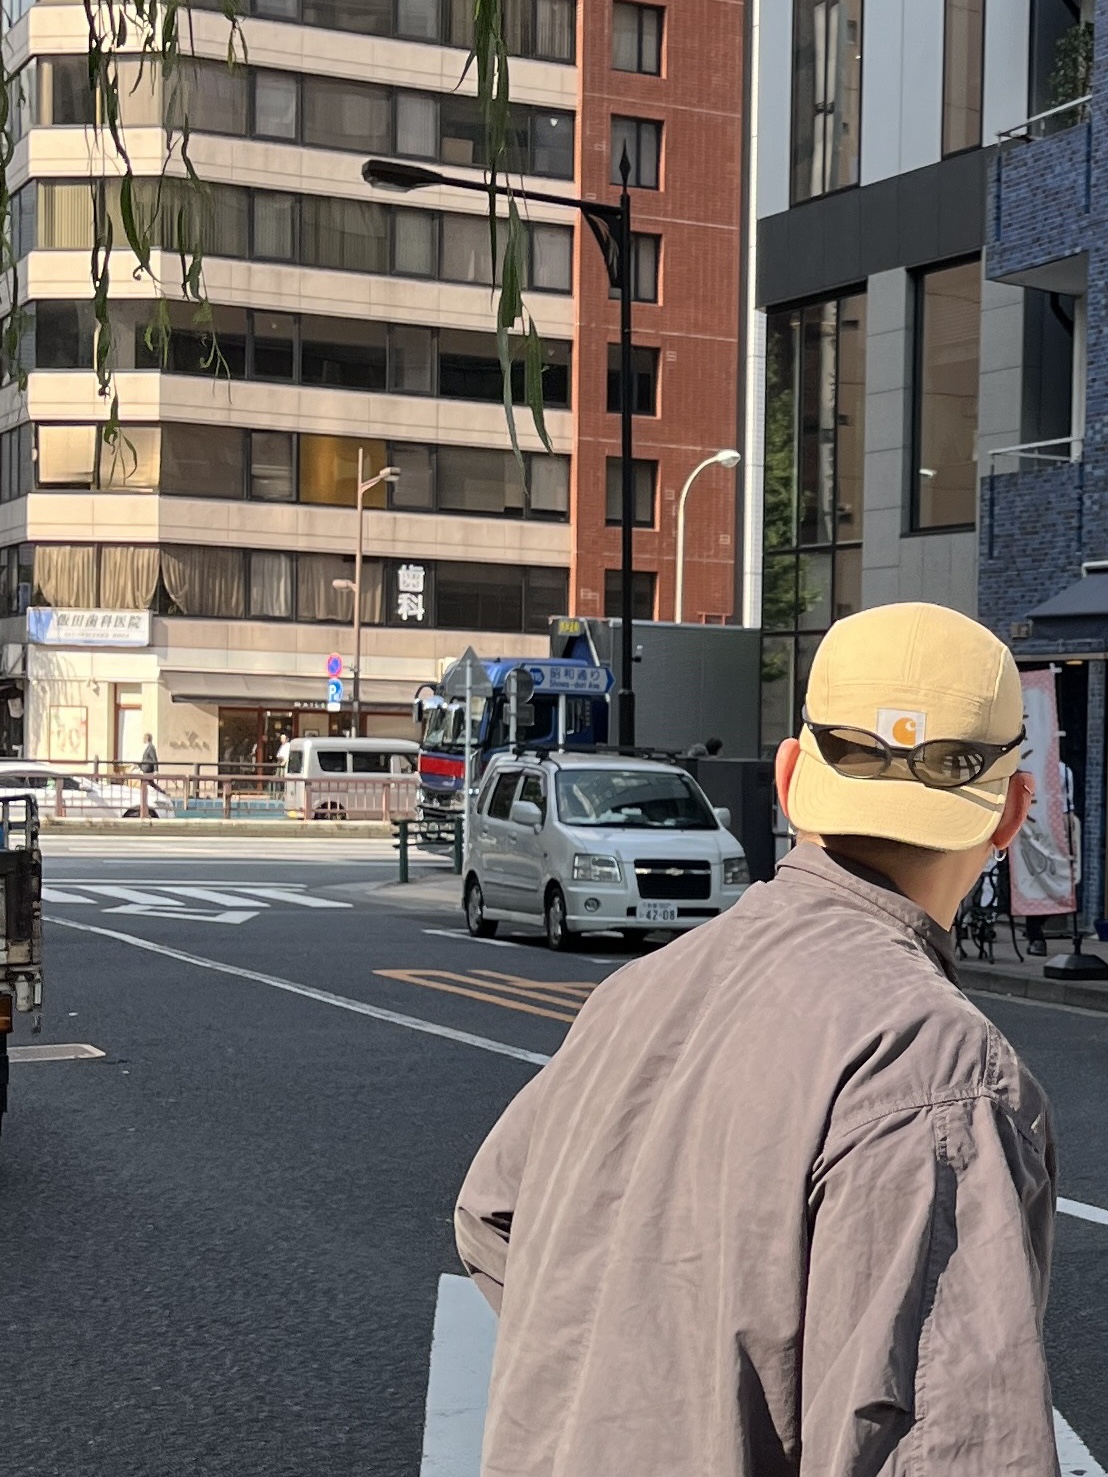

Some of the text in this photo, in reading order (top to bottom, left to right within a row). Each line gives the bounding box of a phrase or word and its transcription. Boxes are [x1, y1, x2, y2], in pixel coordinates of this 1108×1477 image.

[398, 564, 425, 621] 歯科
[550, 667, 600, 680] 昭和通り
